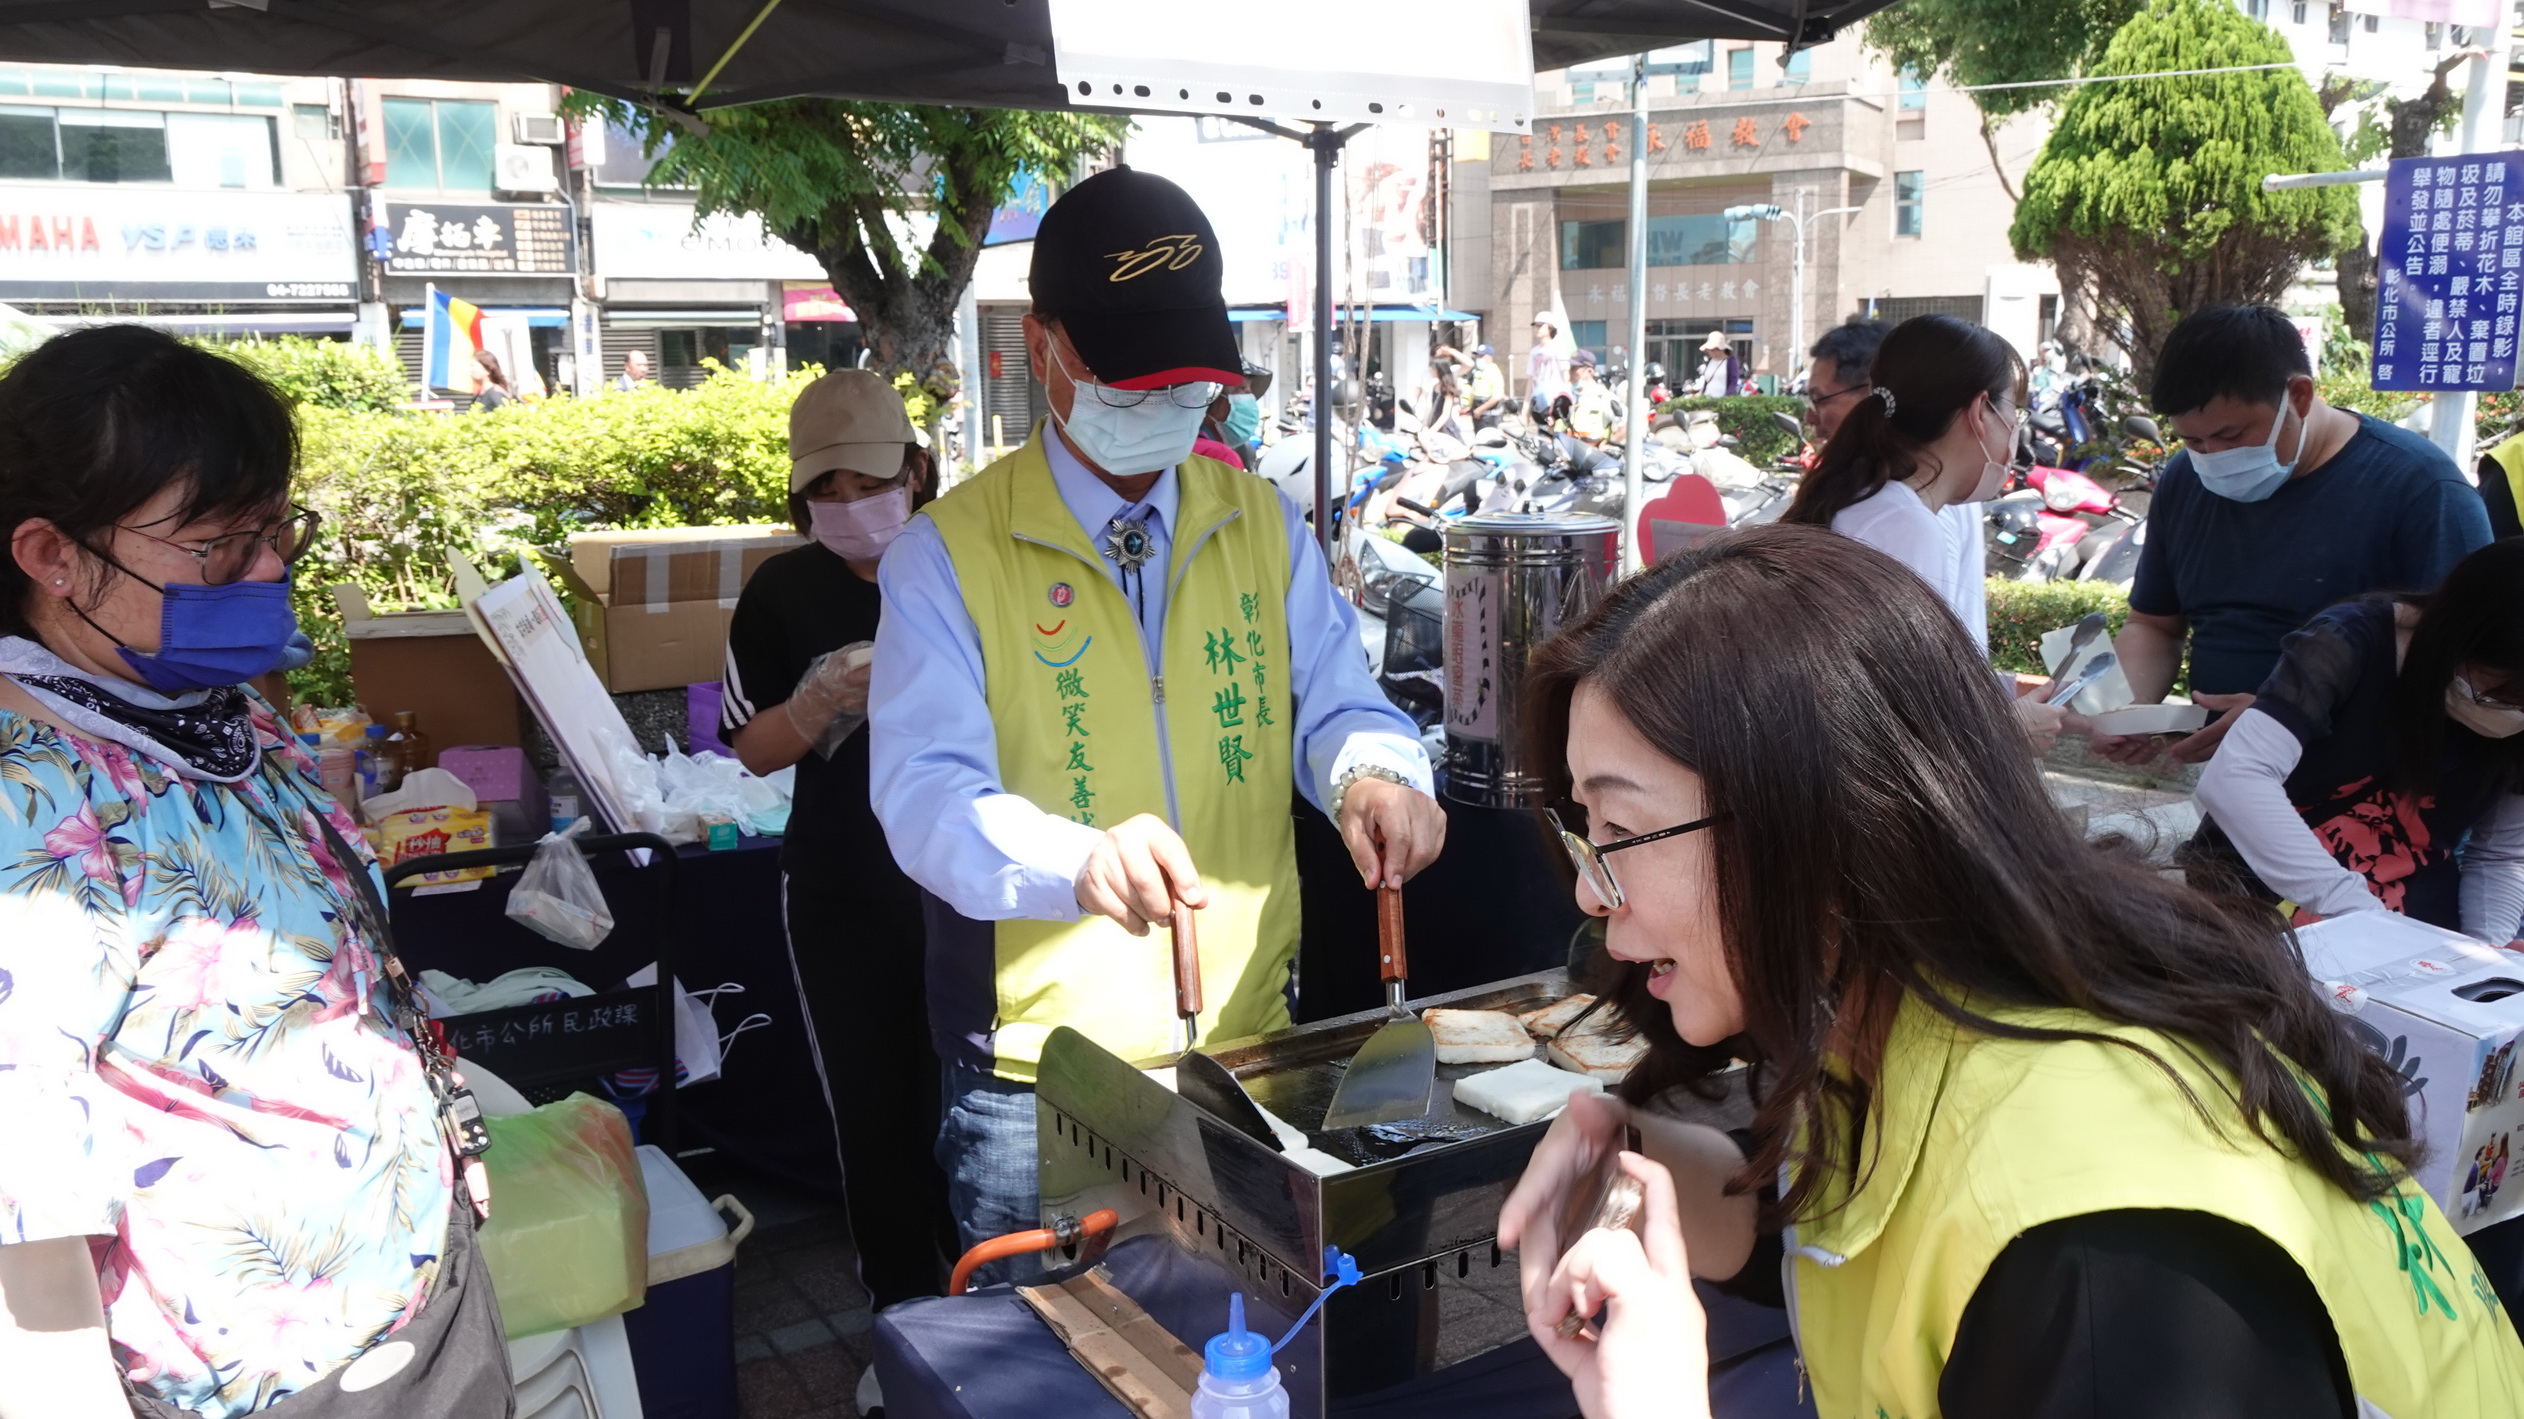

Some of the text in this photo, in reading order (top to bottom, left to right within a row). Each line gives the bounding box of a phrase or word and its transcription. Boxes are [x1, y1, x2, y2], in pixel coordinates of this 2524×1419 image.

[0, 215, 99, 250] MAHA
[1588, 278, 1760, 304] 永福督長老教會
[1240, 592, 1274, 728] 彰化市長
[1203, 627, 1253, 786] 林世賢
